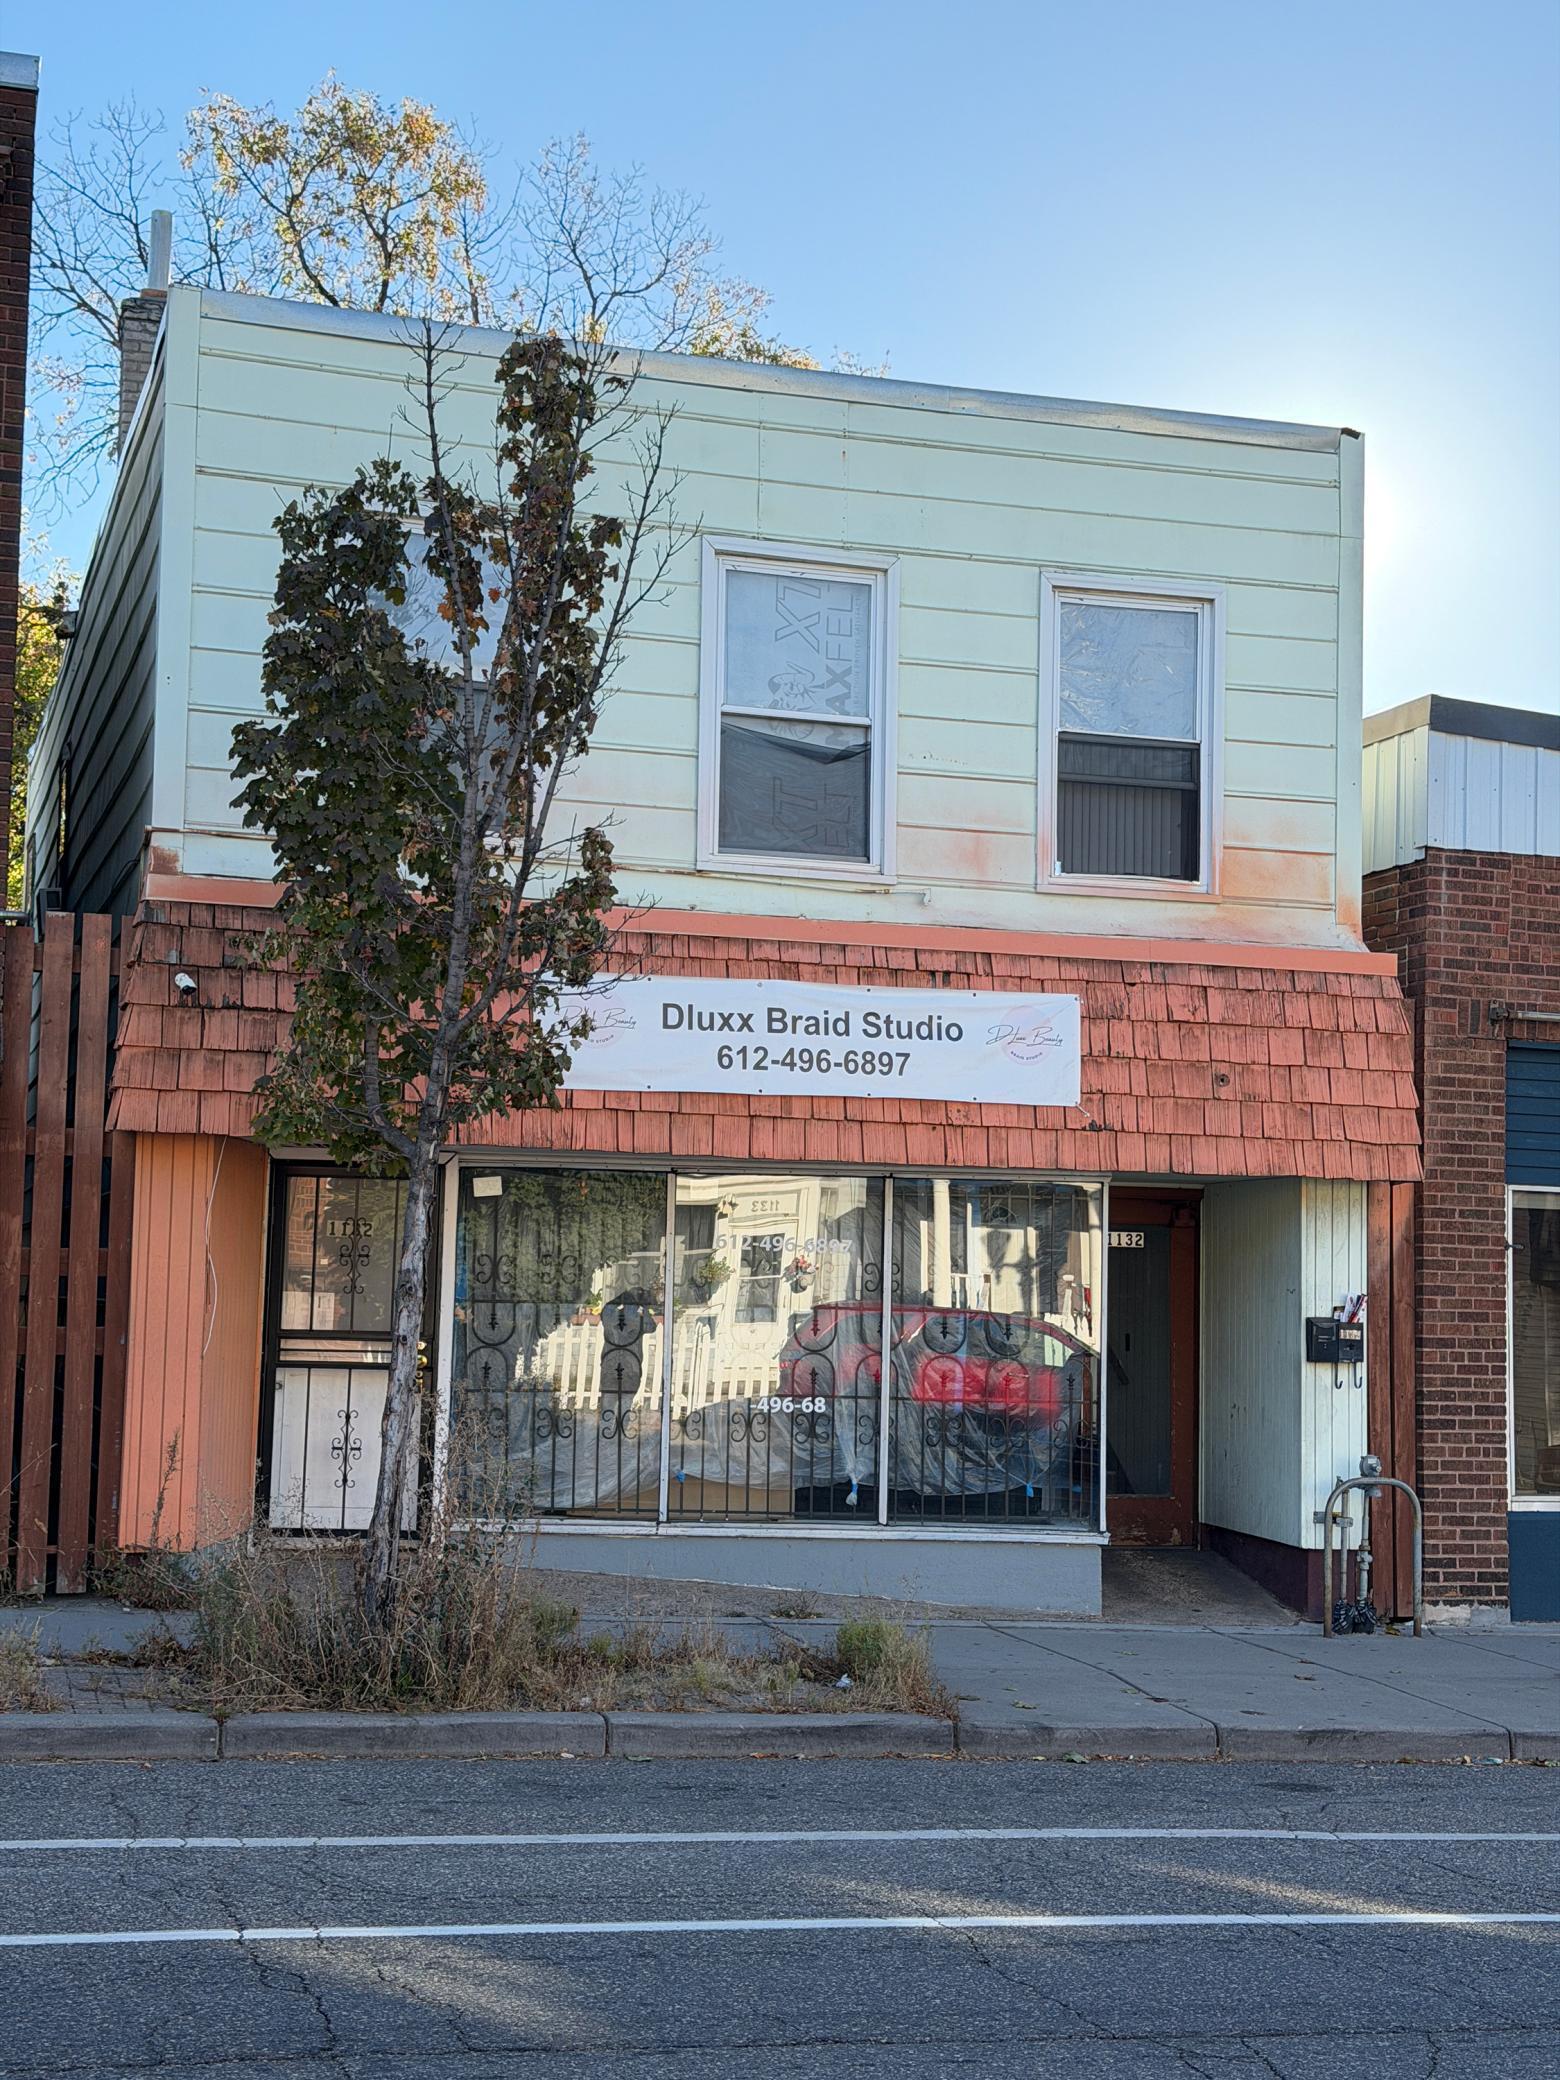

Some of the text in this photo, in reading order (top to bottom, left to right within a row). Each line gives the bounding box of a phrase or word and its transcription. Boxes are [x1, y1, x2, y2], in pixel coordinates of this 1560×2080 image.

[661, 1002, 963, 1042] Dluxx Braid Studio
[716, 1045, 911, 1076] 612-496-6897
[716, 1233, 853, 1254] 612-496-6897
[1108, 1232, 1143, 1247] 1132
[750, 1396, 826, 1413] -496-68
